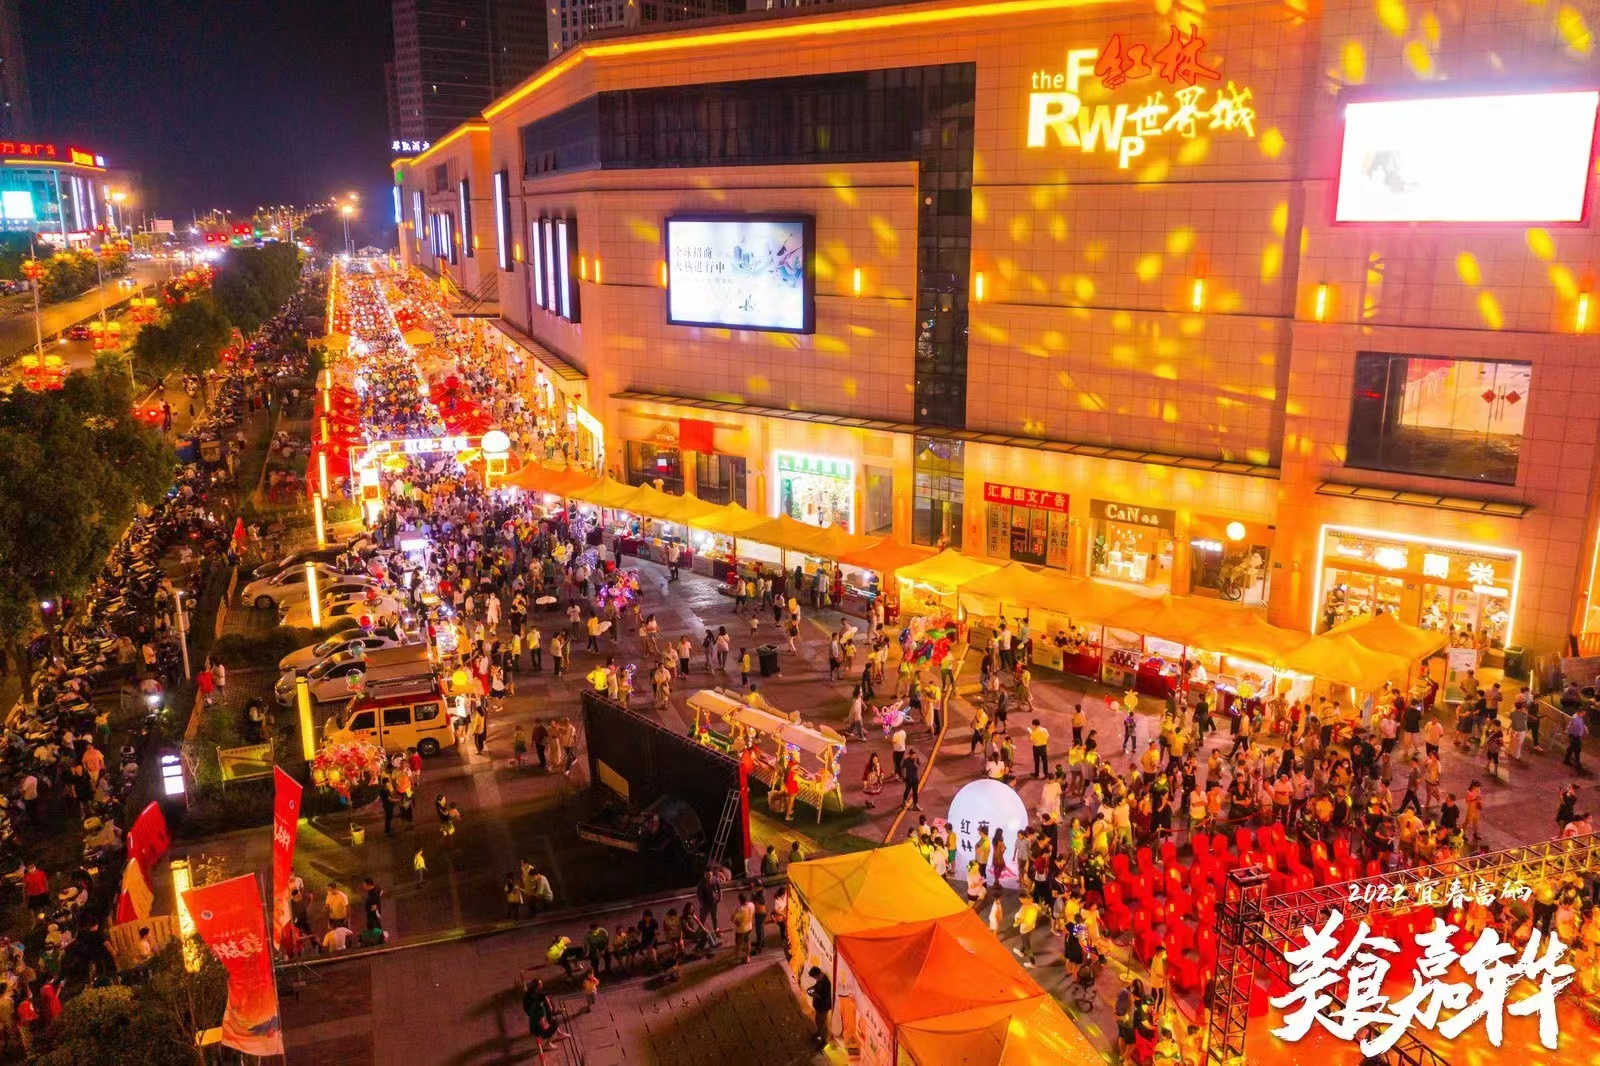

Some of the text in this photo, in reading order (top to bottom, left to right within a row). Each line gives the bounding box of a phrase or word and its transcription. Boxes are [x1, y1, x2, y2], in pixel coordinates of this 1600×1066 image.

[1032, 48, 1098, 91] the F
[1126, 81, 1255, 137] 世界城
